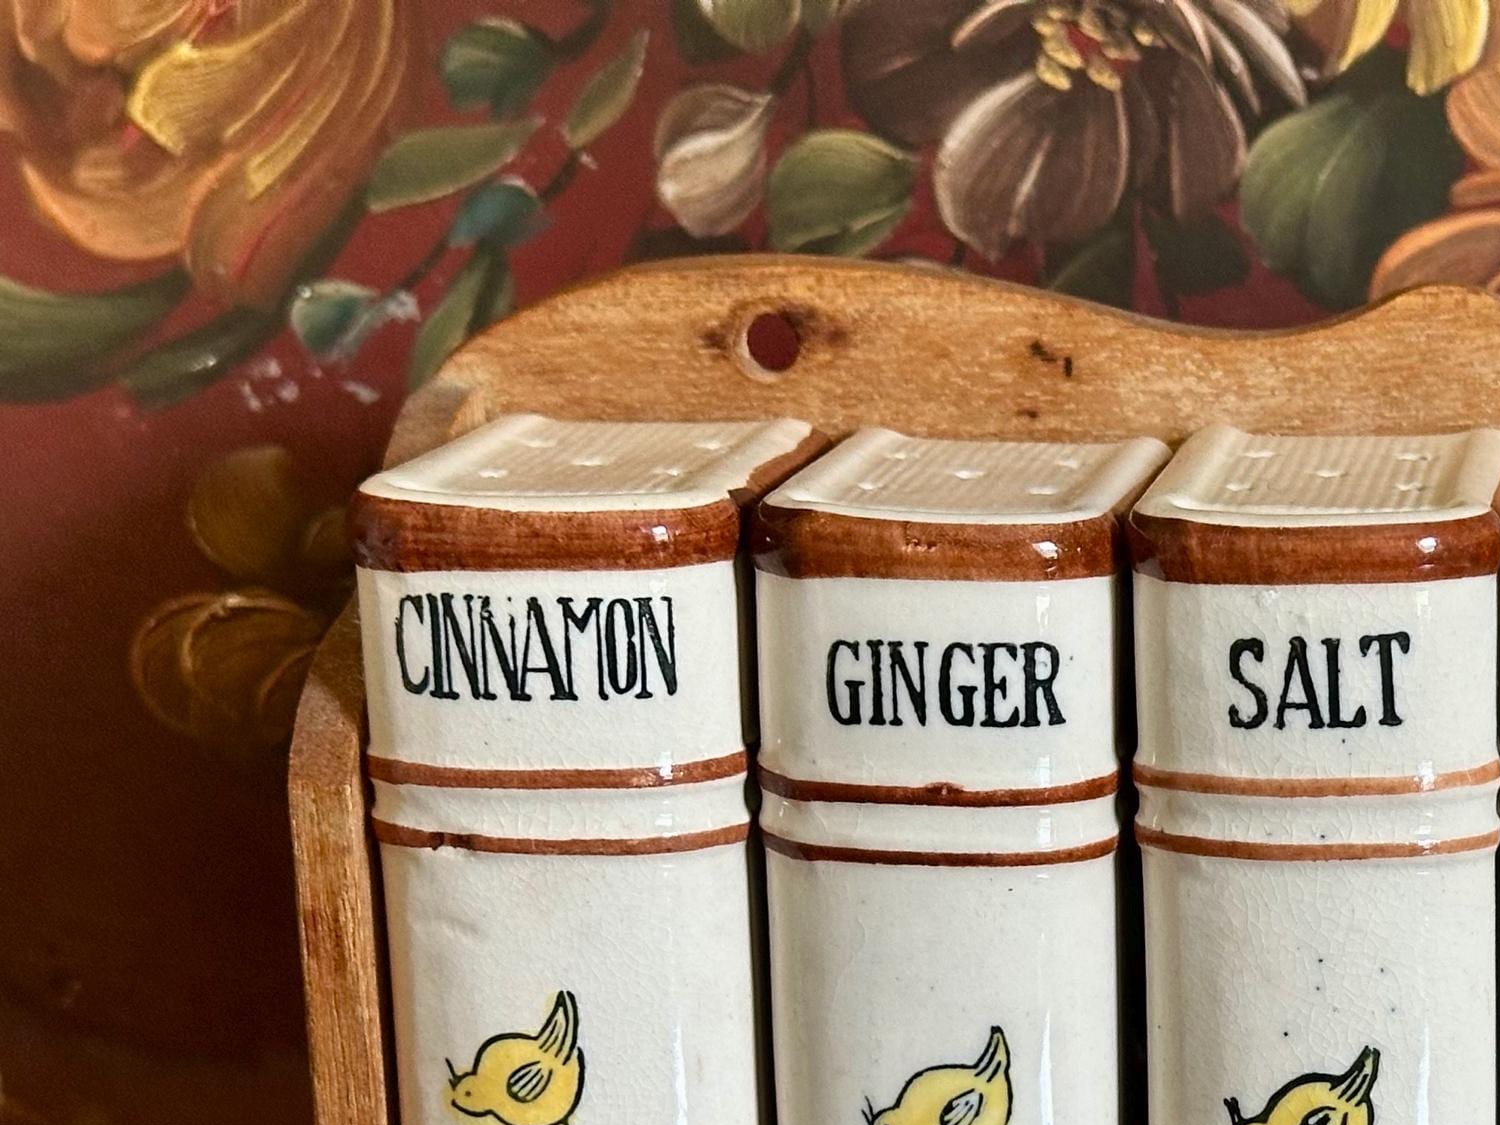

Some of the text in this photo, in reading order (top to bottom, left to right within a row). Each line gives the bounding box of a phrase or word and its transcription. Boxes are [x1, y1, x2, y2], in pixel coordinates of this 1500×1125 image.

[394, 592, 679, 702] CINNAMON
[825, 638, 1068, 729] GINGER
[1227, 631, 1411, 731] SALT
